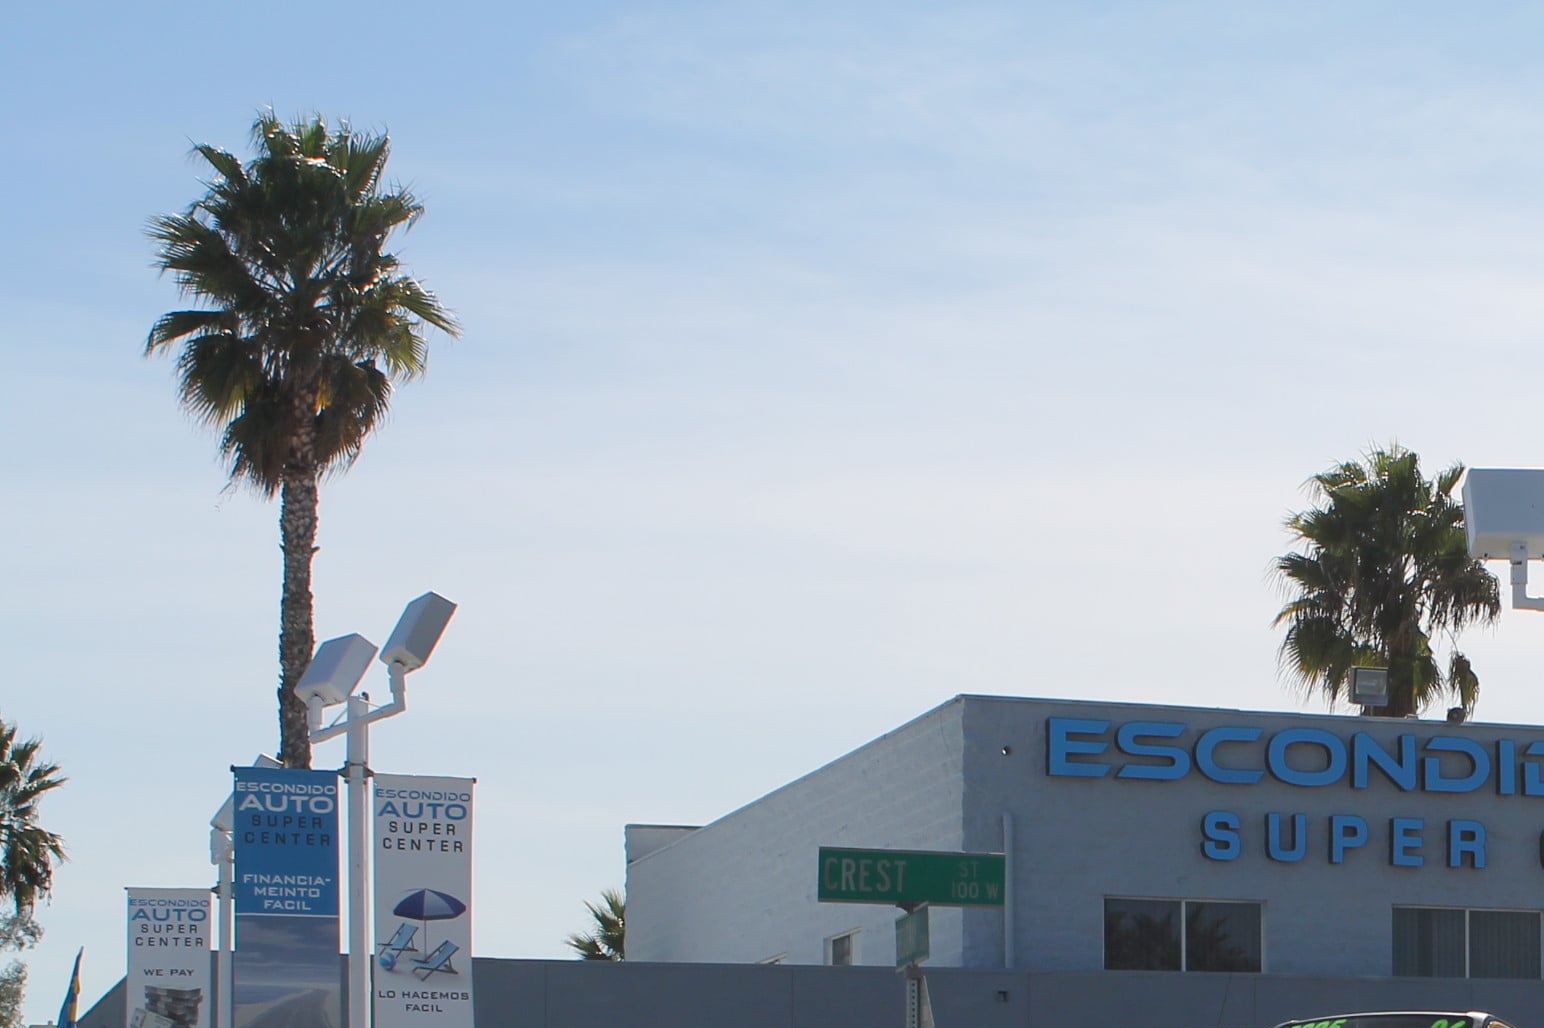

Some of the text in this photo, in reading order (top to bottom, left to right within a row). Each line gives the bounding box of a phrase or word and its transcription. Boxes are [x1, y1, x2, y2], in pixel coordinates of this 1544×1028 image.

[236, 782, 336, 795] ESCONDIDO
[375, 788, 471, 802] ESCONDIDO
[239, 793, 334, 813] AUTO
[378, 800, 467, 820] AUTO
[252, 814, 322, 829] SUPER
[389, 821, 456, 836] SUPER
[244, 831, 330, 846] CENTER
[383, 837, 463, 852] CENTER
[1202, 810, 1486, 868] SUPER
[823, 857, 907, 893] CREST
[959, 861, 980, 878] ST
[243, 874, 331, 886] FINANCIA-
[254, 886, 320, 897] MEINTO
[952, 882, 998, 899] 100 W
[129, 898, 210, 908] ESCONDIDO
[264, 899, 311, 910] FACIL
[132, 908, 207, 921] AUTO
[141, 923, 197, 933] SUPER
[135, 936, 203, 947] CENTER
[379, 990, 469, 1000] LO HACEMOS
[406, 1004, 443, 1012] FACIL
